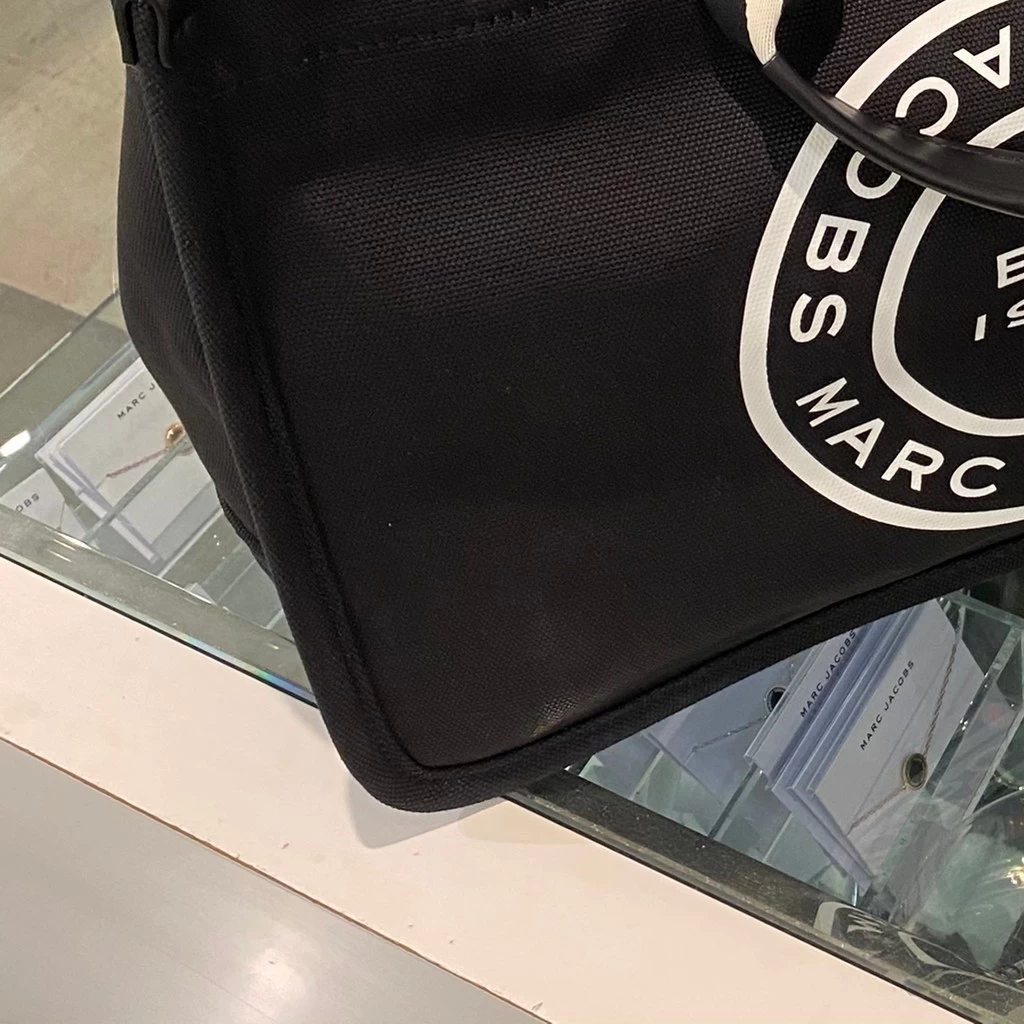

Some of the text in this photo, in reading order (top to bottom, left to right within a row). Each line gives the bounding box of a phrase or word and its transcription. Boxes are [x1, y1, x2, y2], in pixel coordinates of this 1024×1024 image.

[117, 392, 146, 418] MARC
[796, 377, 1006, 498] MARC
[800, 630, 857, 718] MARC JACOBS
[860, 660, 914, 750] MARC JACOBS
